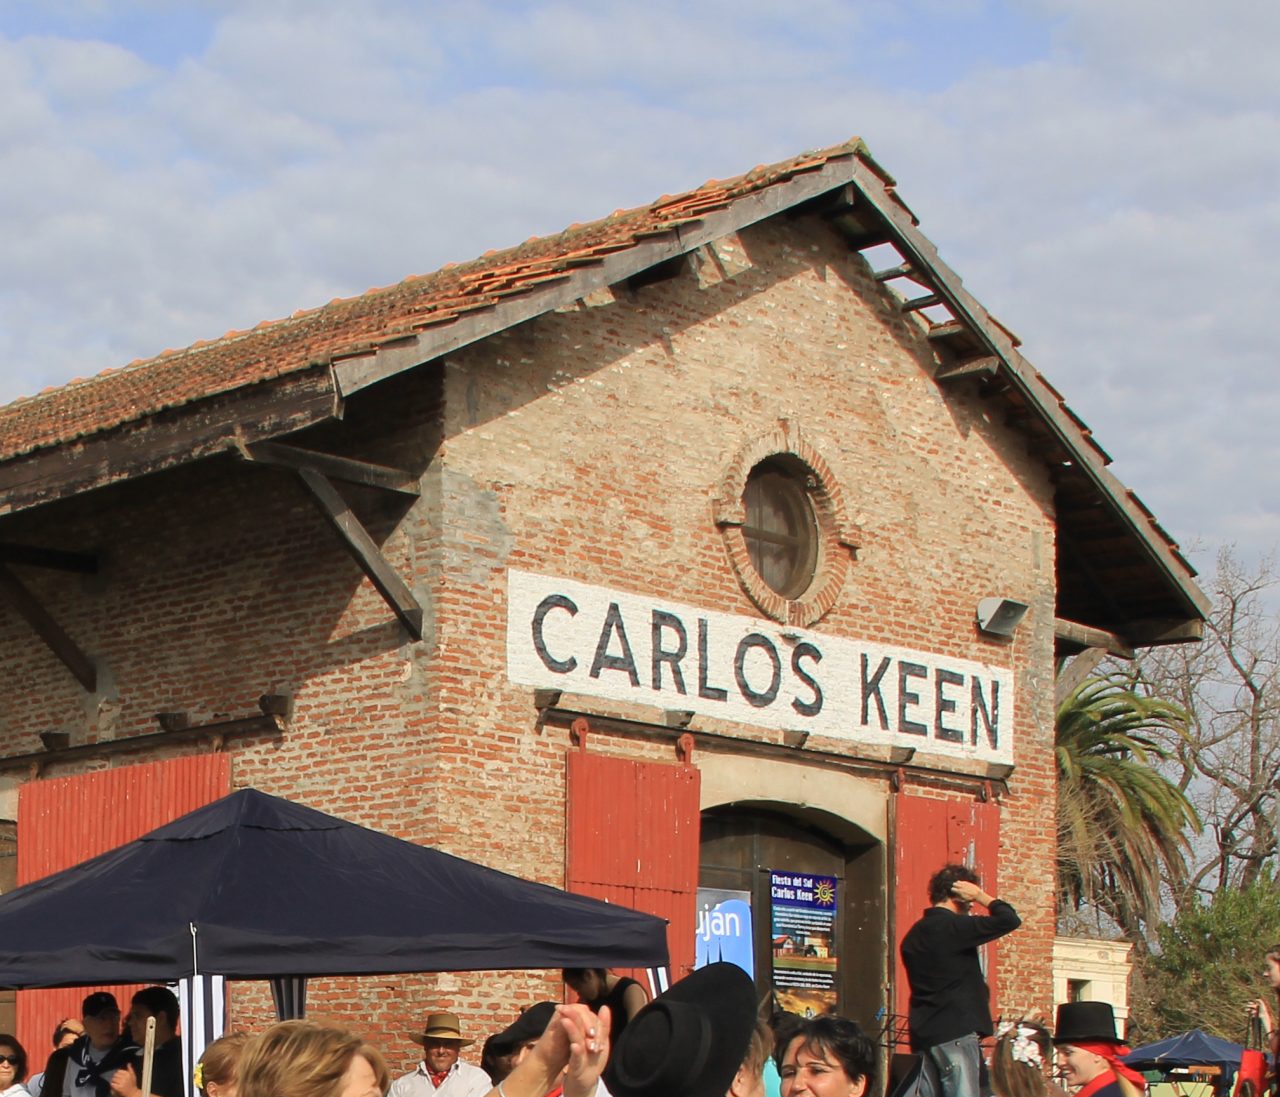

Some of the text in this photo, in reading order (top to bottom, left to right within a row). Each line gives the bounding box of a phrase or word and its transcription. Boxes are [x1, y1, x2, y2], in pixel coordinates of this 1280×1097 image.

[531, 594, 1001, 750] CARLOS KEEN
[771, 874, 813, 888] Fiesta del Sol
[771, 886, 813, 901] Carlos Keen
[695, 903, 740, 941] uján
